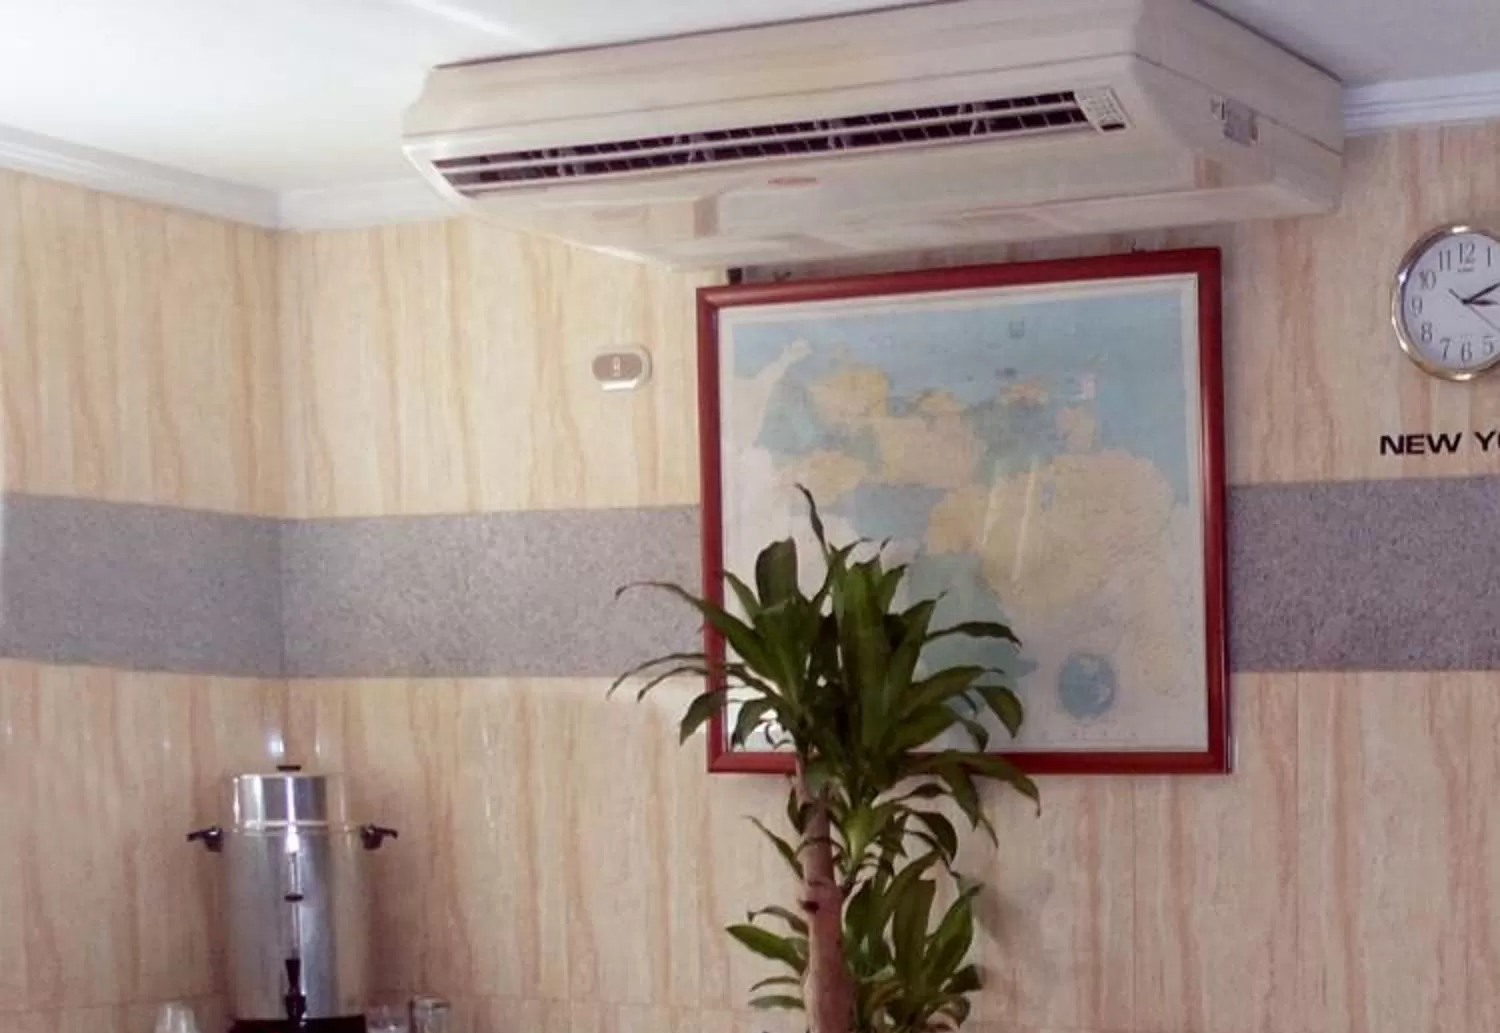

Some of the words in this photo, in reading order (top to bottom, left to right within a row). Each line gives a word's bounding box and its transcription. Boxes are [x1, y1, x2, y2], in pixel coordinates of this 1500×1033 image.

[1438, 250, 1451, 272] 11
[1458, 243, 1476, 264] 12
[1486, 247, 1492, 267] 1
[1419, 271, 1436, 289] 10
[1411, 298, 1422, 316] 9
[1421, 323, 1433, 342] 8
[1440, 339, 1452, 361] 7
[1461, 342, 1472, 362] 6
[1482, 336, 1495, 355] 5
[1380, 432, 1462, 455] NEW
